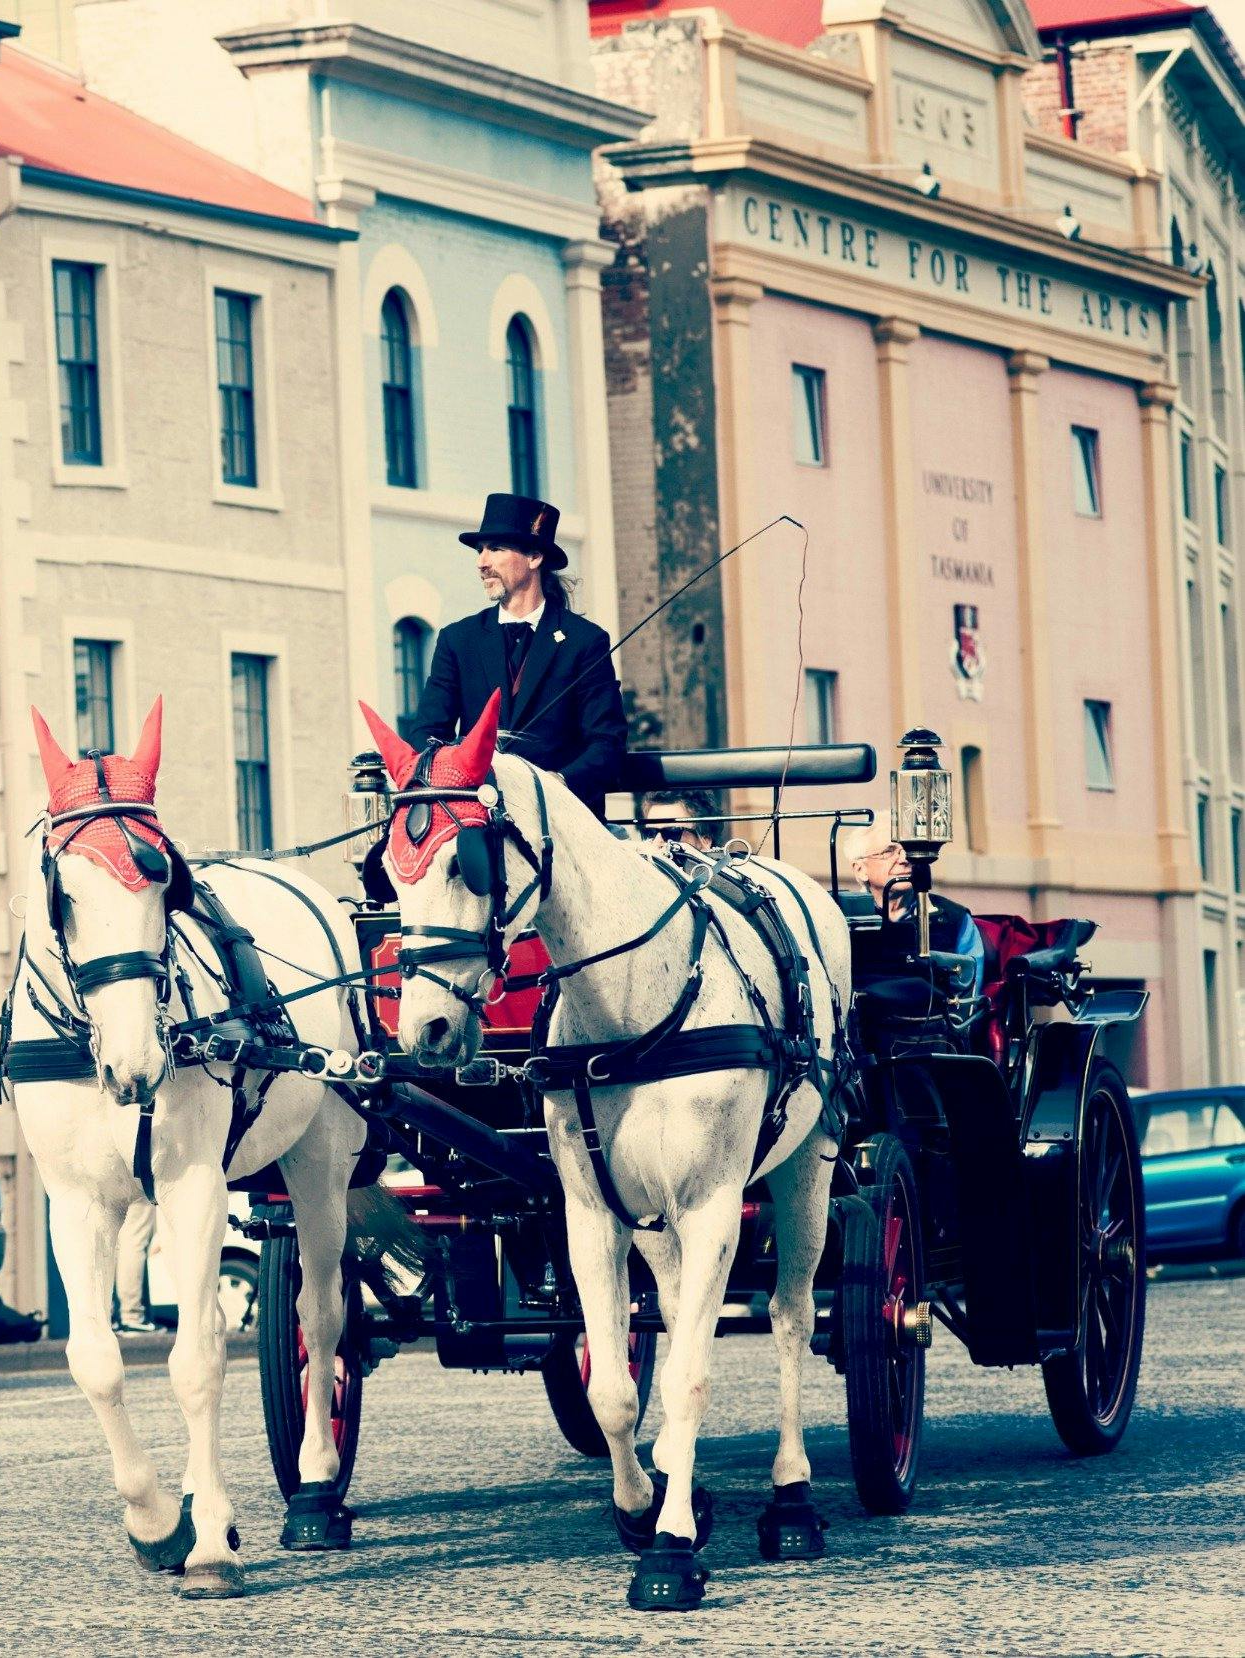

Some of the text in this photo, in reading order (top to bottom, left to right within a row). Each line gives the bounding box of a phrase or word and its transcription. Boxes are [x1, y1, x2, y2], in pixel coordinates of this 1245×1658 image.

[744, 197, 1150, 340] CENTRE FOR THE ARTS
